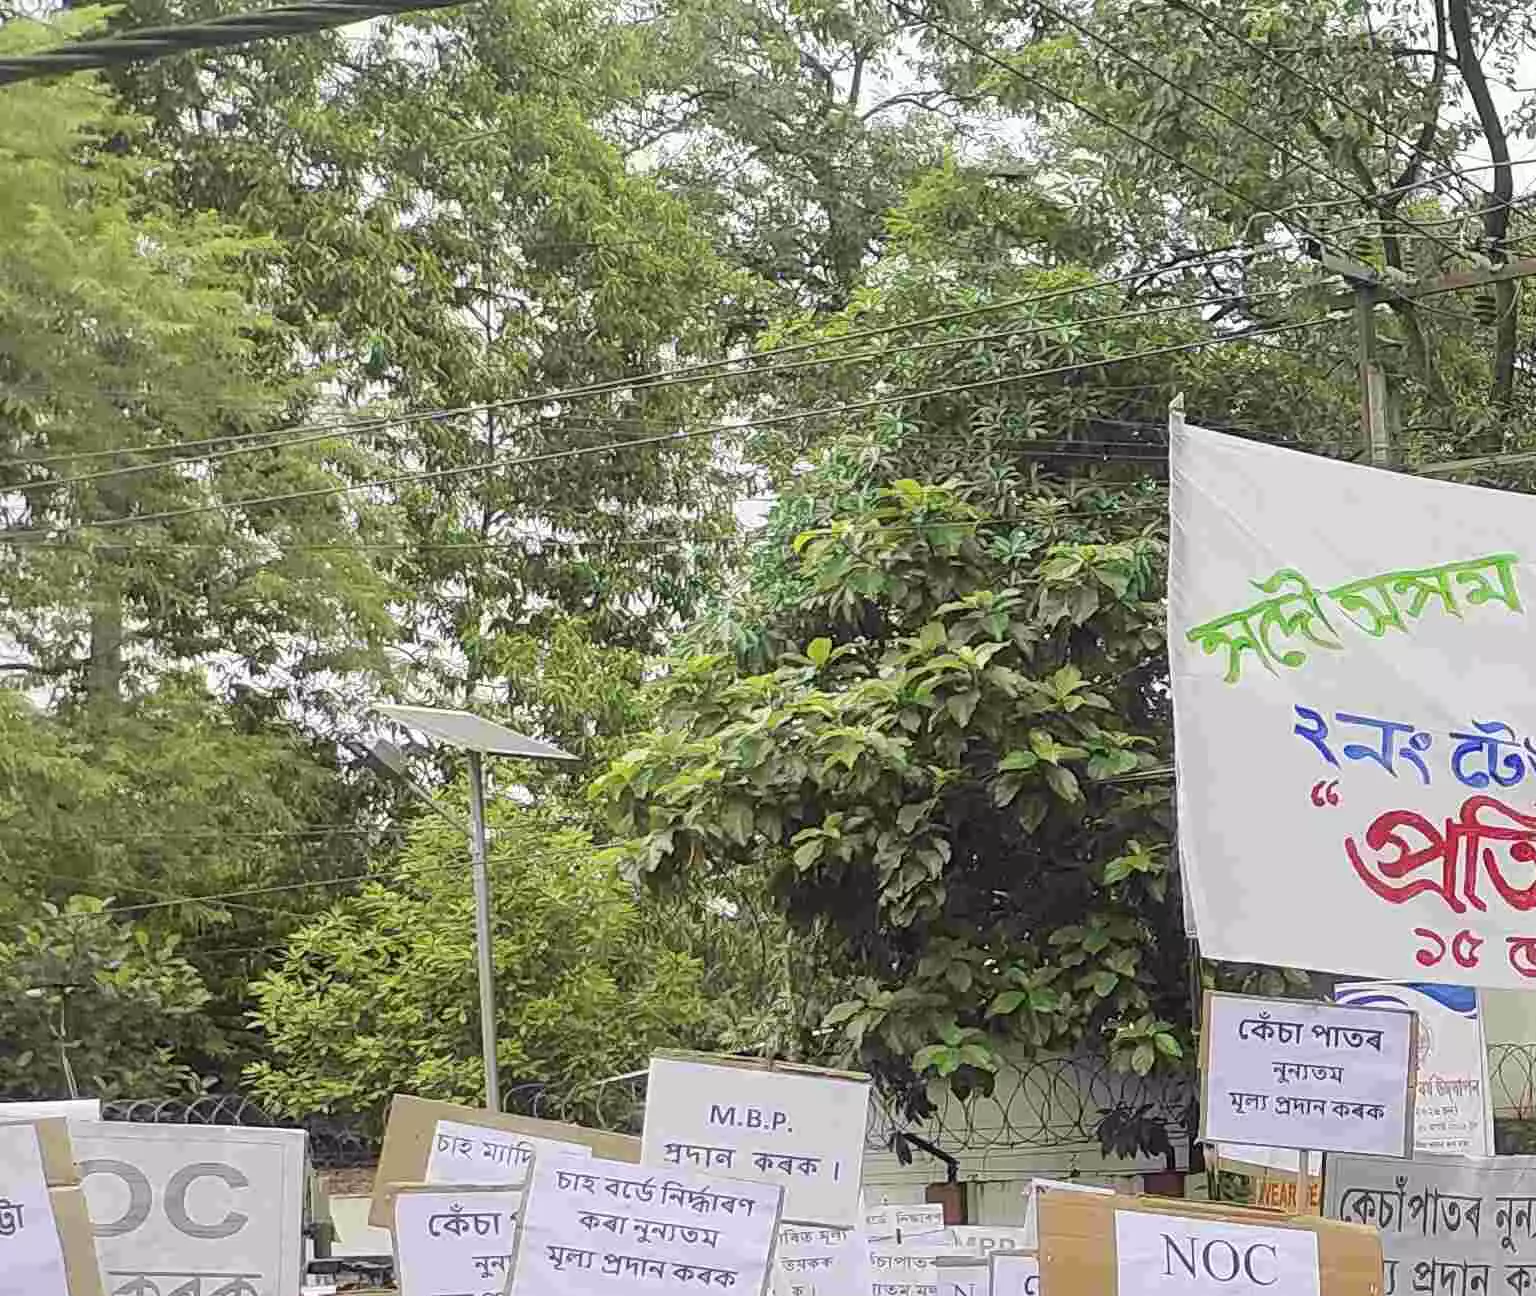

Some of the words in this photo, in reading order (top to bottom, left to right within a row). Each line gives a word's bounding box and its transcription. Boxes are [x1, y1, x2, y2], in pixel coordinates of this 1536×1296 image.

[1412, 927, 1485, 969] ১৫
[1239, 1007, 1304, 1045] কেঁচা
[1311, 1025, 1385, 1052] পাতৰ
[709, 1104, 794, 1133] M.B.P.
[1274, 1094, 1328, 1118] প্ৰদান
[1332, 1101, 1385, 1122] কৰক
[437, 1132, 472, 1159] চাহ
[664, 1141, 737, 1171] প্ৰদান
[752, 1150, 822, 1177] কৰক
[556, 1170, 600, 1194] চাহ
[428, 1202, 501, 1238] কেঁচা
[577, 1210, 628, 1235] কৰা
[602, 1252, 667, 1278] প্ৰদান
[671, 1263, 738, 1288] কৰক
[1161, 1233, 1279, 1287] NOC
